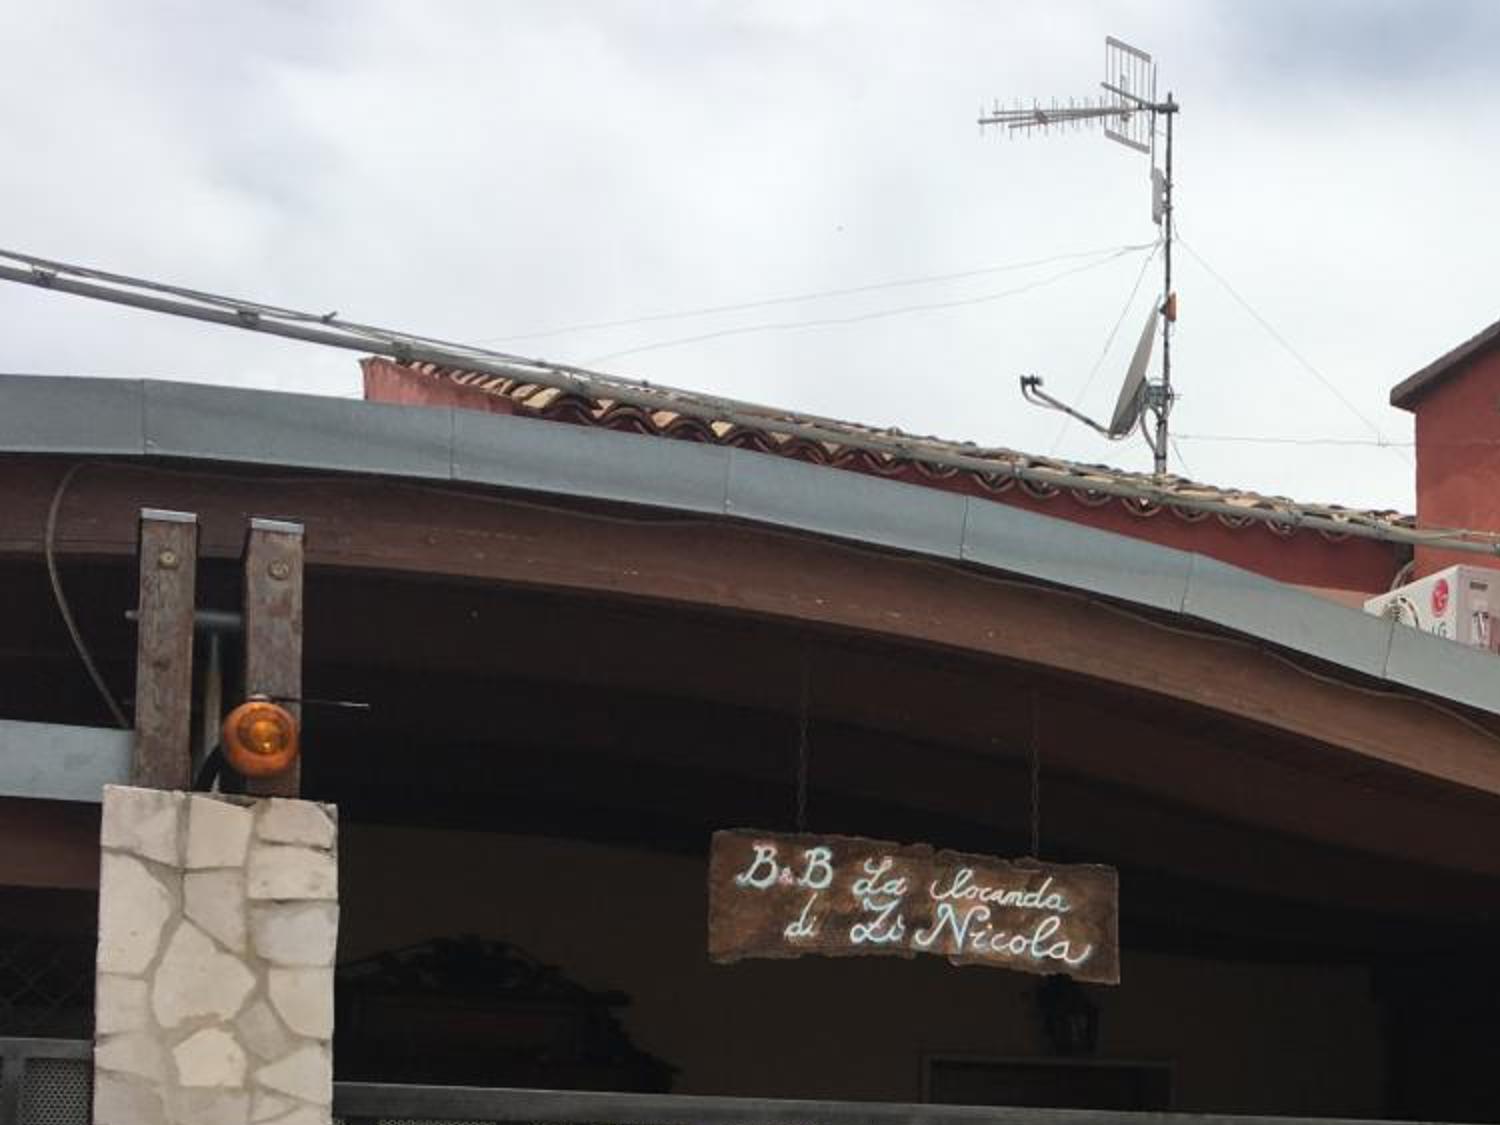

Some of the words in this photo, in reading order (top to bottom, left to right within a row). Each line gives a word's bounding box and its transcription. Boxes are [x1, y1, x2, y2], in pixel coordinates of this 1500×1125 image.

[736, 843, 833, 889] B&B
[852, 856, 907, 896] La
[784, 893, 819, 937] di
[914, 902, 1093, 964] Nicola
